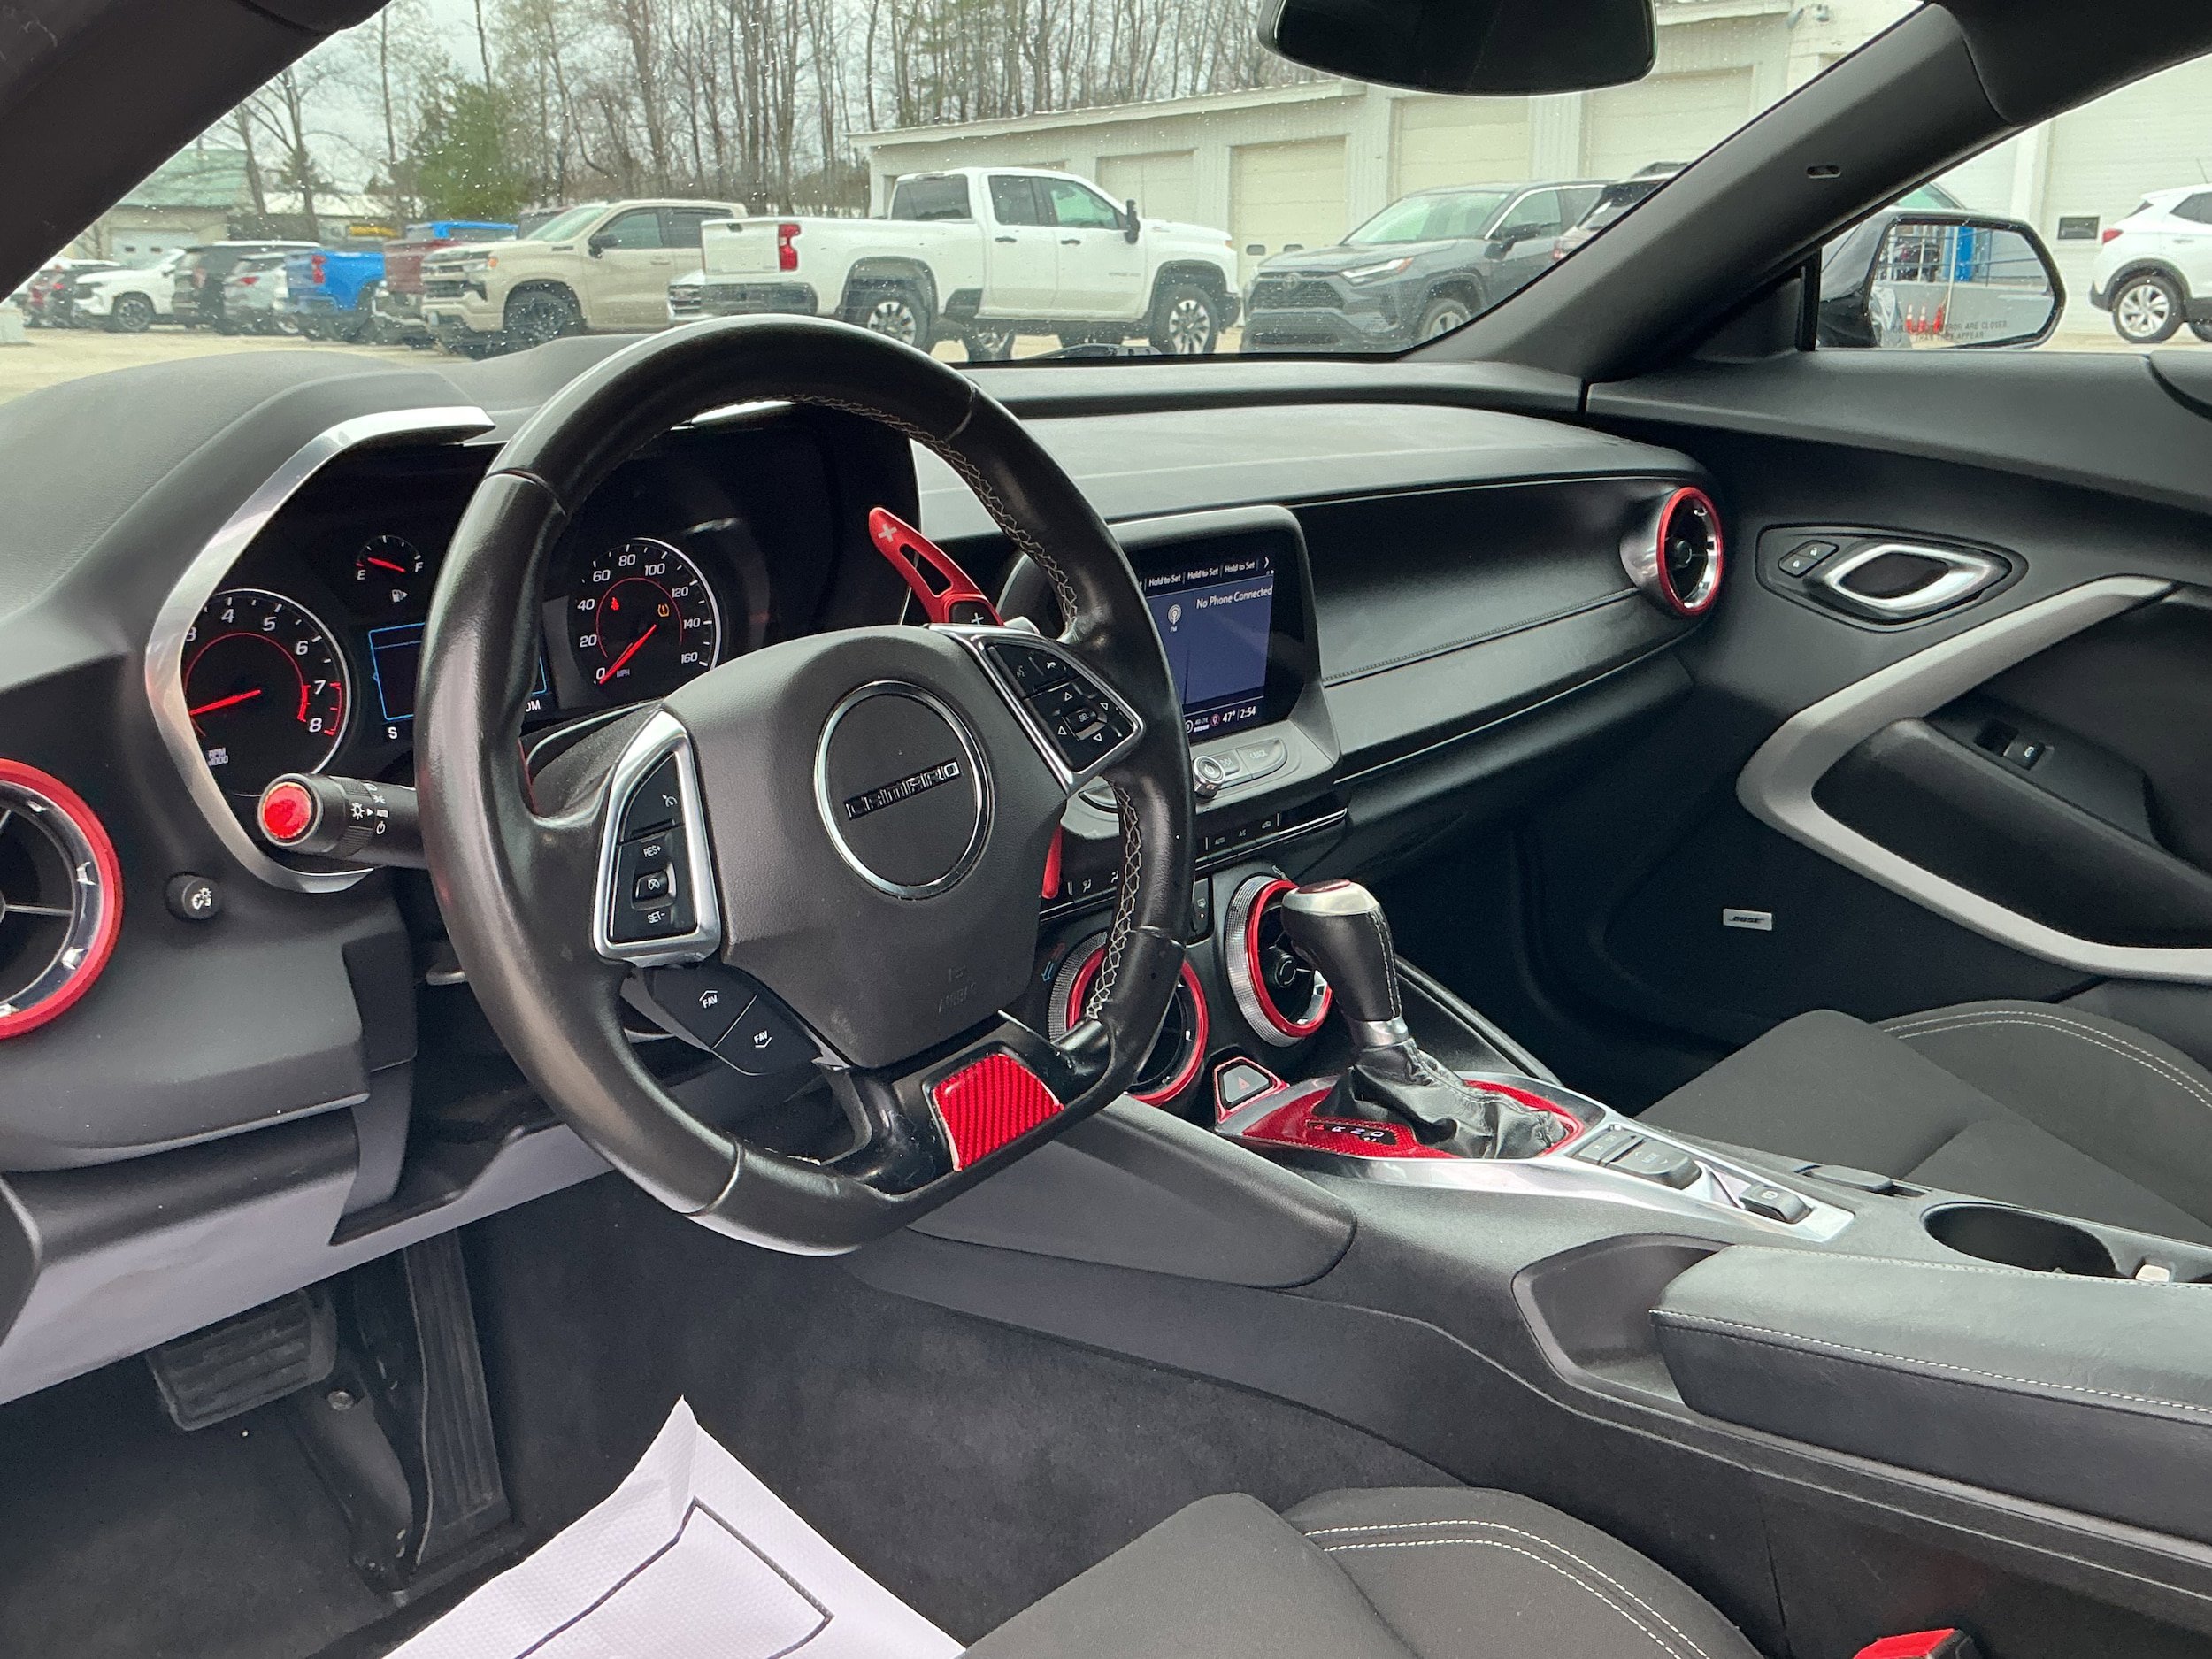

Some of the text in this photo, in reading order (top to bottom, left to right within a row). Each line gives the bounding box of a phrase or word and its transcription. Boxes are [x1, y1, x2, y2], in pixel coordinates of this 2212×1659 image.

[415, 561, 424, 572] F
[618, 554, 636, 567] 80
[1224, 564, 1238, 573] Hold
[1246, 561, 1256, 570] Set
[357, 569, 366, 580] E
[593, 569, 611, 582] 60
[644, 563, 665, 576] 100
[1187, 571, 1202, 580] Hold
[1209, 567, 1219, 577] Set
[1148, 578, 1164, 588] Hold
[1171, 574, 1182, 583] Set
[672, 586, 689, 598] 120
[1196, 585, 1273, 610] No Phone Connected
[577, 598, 595, 611] 40
[221, 609, 234, 623] 4
[263, 616, 277, 632] 5
[683, 618, 701, 629] 140
[186, 626, 197, 641] 3
[296, 640, 309, 656] 6
[579, 634, 597, 648] 20
[680, 651, 698, 664] 160
[595, 667, 606, 680] 0
[314, 680, 327, 695] 7
[1222, 710, 1236, 723] 47°
[1240, 705, 1256, 719] 2:54
[309, 718, 323, 733] 8
[388, 726, 398, 740] S
[844, 760, 961, 819] CAMARO
[643, 845, 662, 857] RES+
[647, 910, 666, 924] SET-
[702, 994, 718, 1009] FAV
[753, 1029, 769, 1044] FAV
